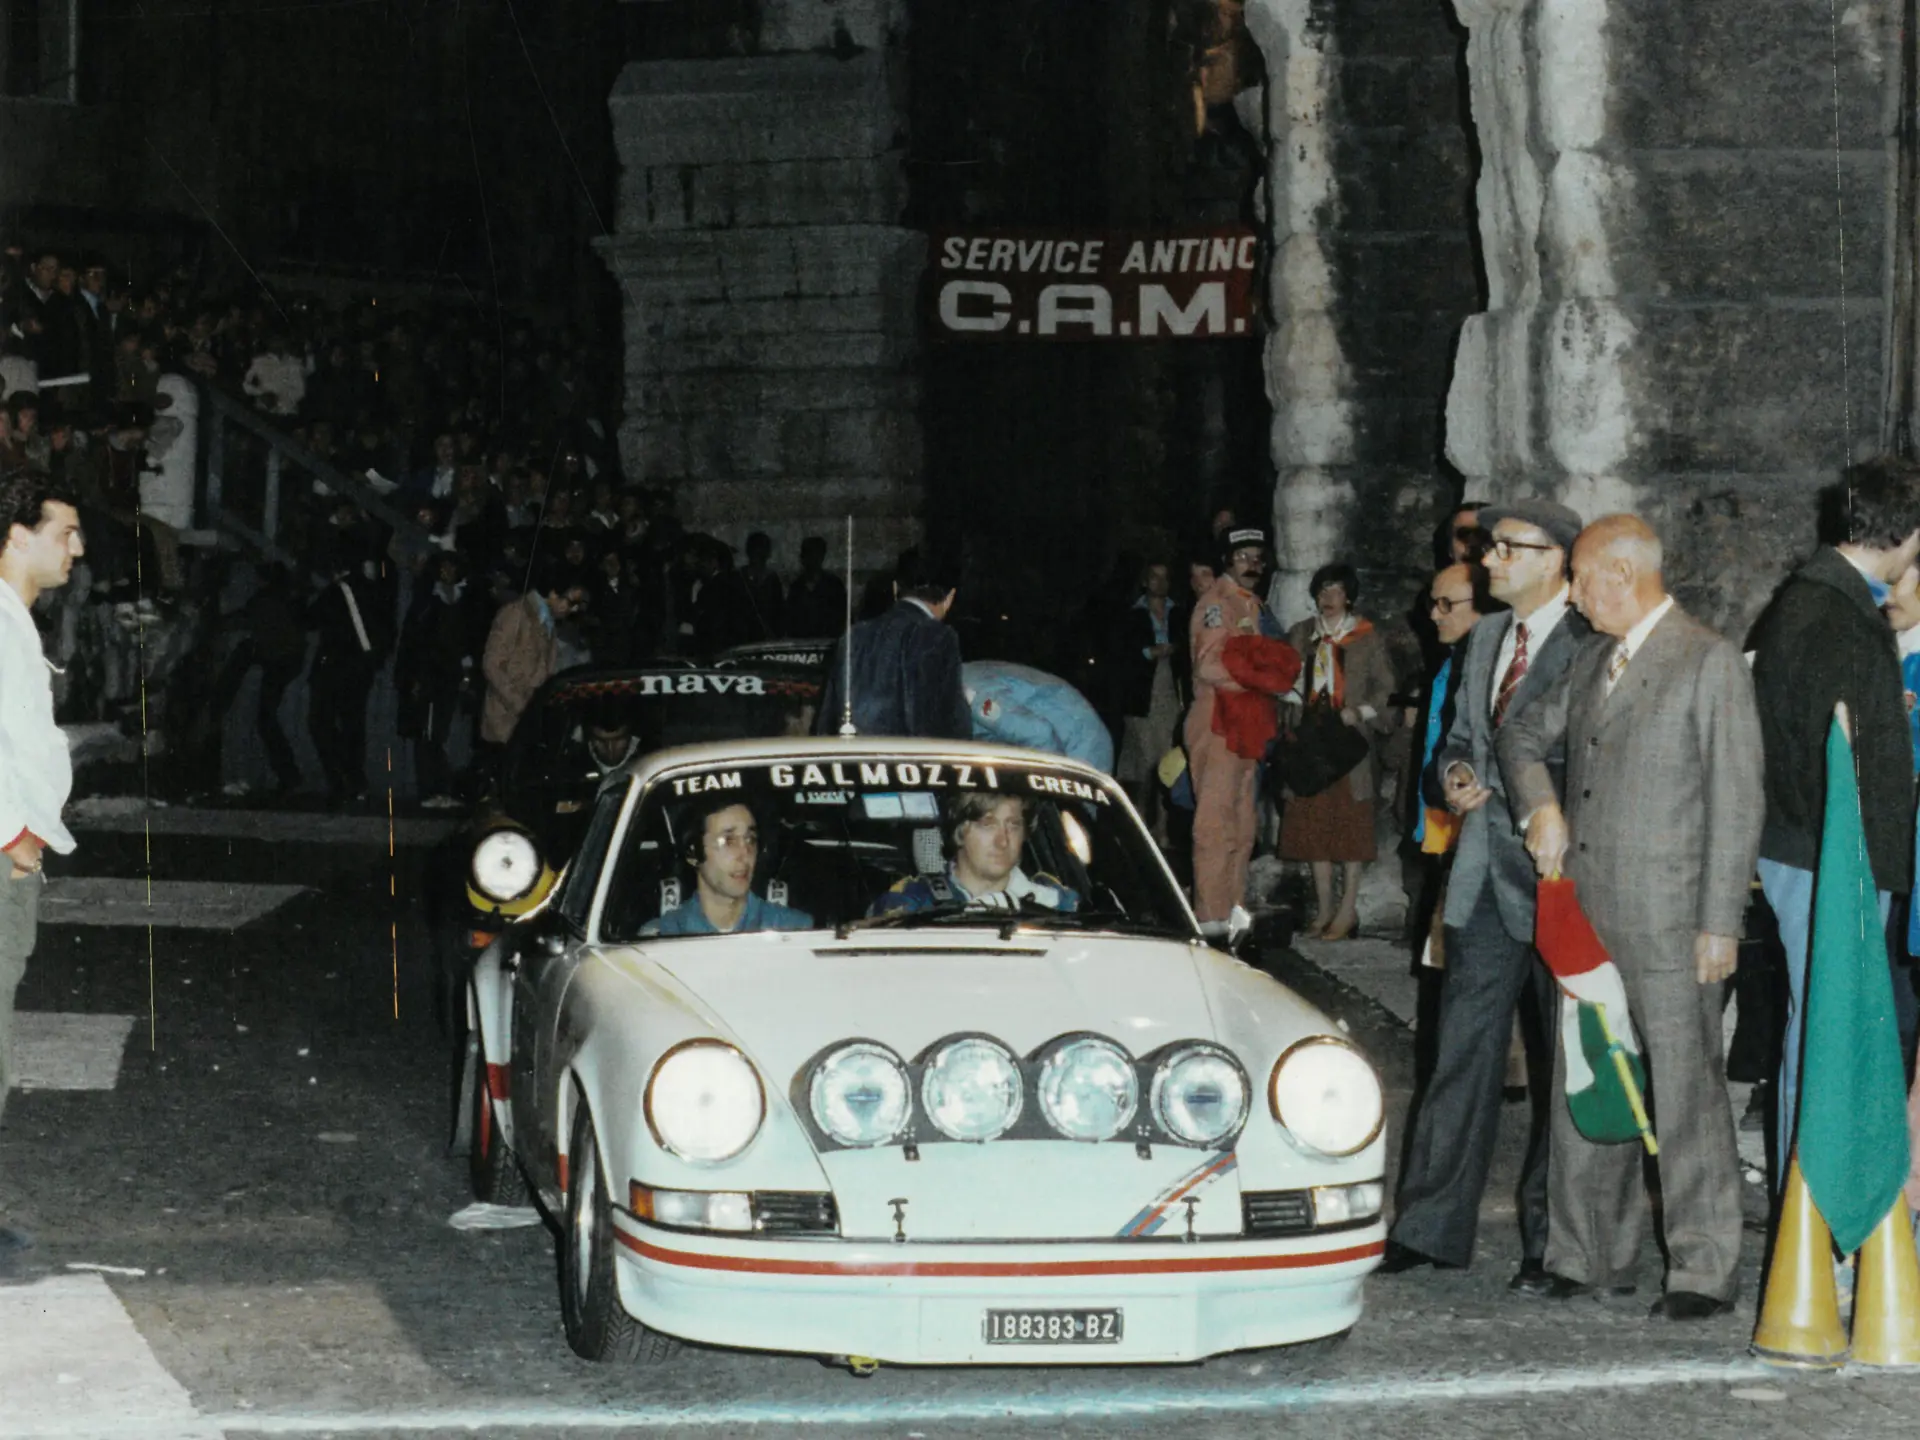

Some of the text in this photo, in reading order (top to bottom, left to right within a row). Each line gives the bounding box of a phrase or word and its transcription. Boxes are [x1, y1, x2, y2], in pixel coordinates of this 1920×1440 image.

[941, 237, 1104, 273] SERVICE
[939, 279, 1245, 336] C.A.M.
[640, 673, 767, 695] nava
[672, 762, 1112, 806] TEAM GALMOZZI CREMA
[992, 1313, 1116, 1339] 188383 BZ
